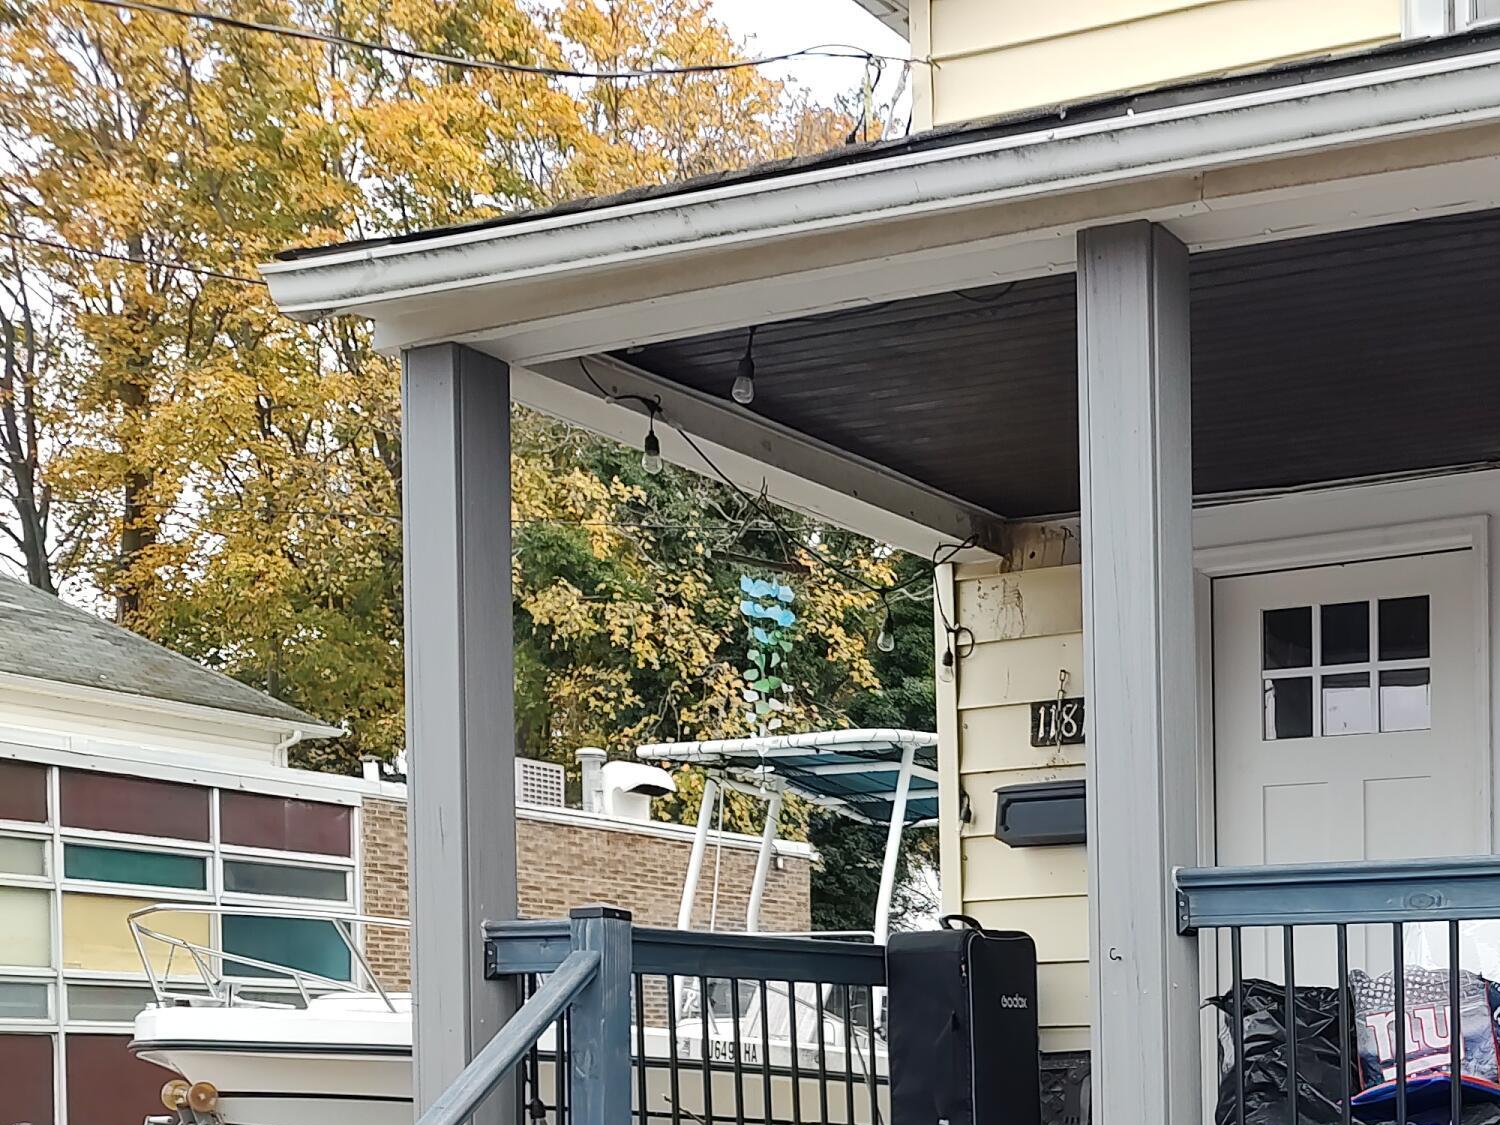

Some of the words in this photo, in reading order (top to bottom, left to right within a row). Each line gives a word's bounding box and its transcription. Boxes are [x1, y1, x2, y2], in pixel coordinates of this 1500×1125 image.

[1038, 703, 1085, 742] 118
[1001, 992, 1028, 1008] Godox
[702, 1039, 737, 1060] J649
